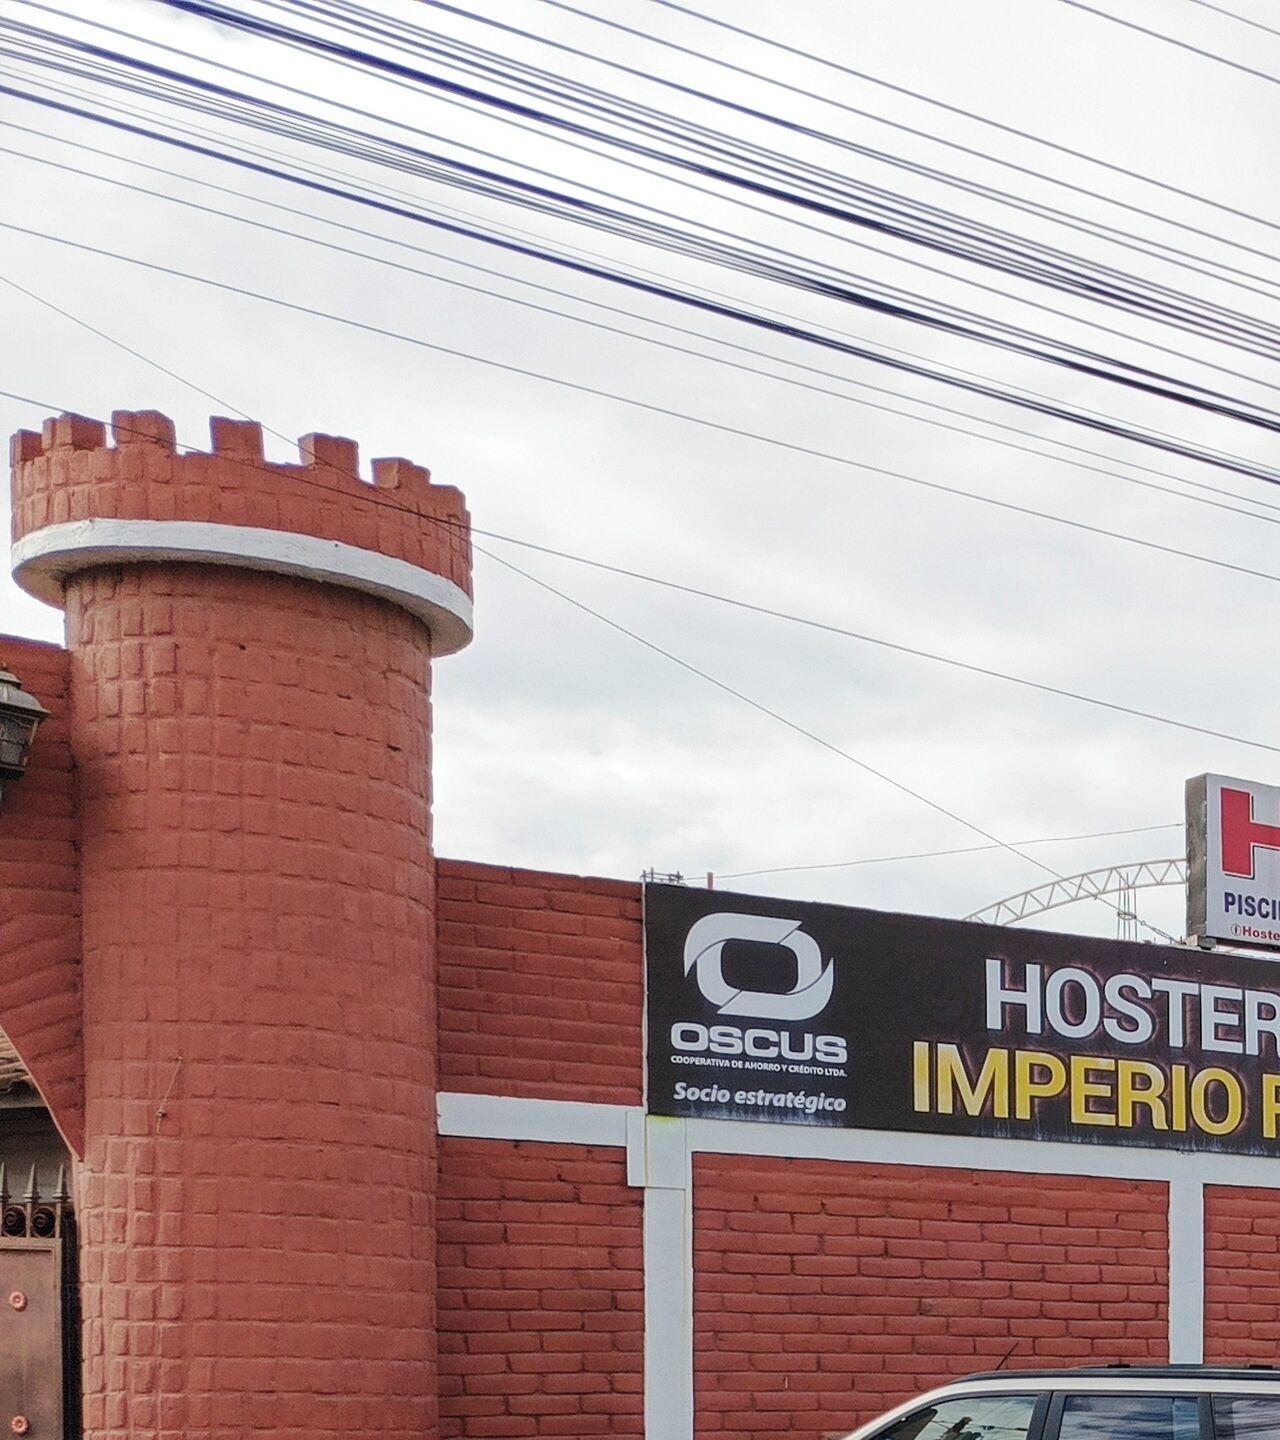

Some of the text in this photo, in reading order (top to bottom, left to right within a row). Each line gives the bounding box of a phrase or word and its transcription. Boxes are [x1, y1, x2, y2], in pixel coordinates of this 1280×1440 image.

[671, 1022, 848, 1063] OSCUS
[670, 1055, 730, 1068] COOPERATIVA
[745, 1062, 781, 1072] AHORRO
[781, 1064, 788, 1072] Y
[789, 1064, 823, 1075] CRÉDITO
[673, 1081, 847, 1113] Socio estratégico
[913, 1040, 1242, 1136] IMPERIO
